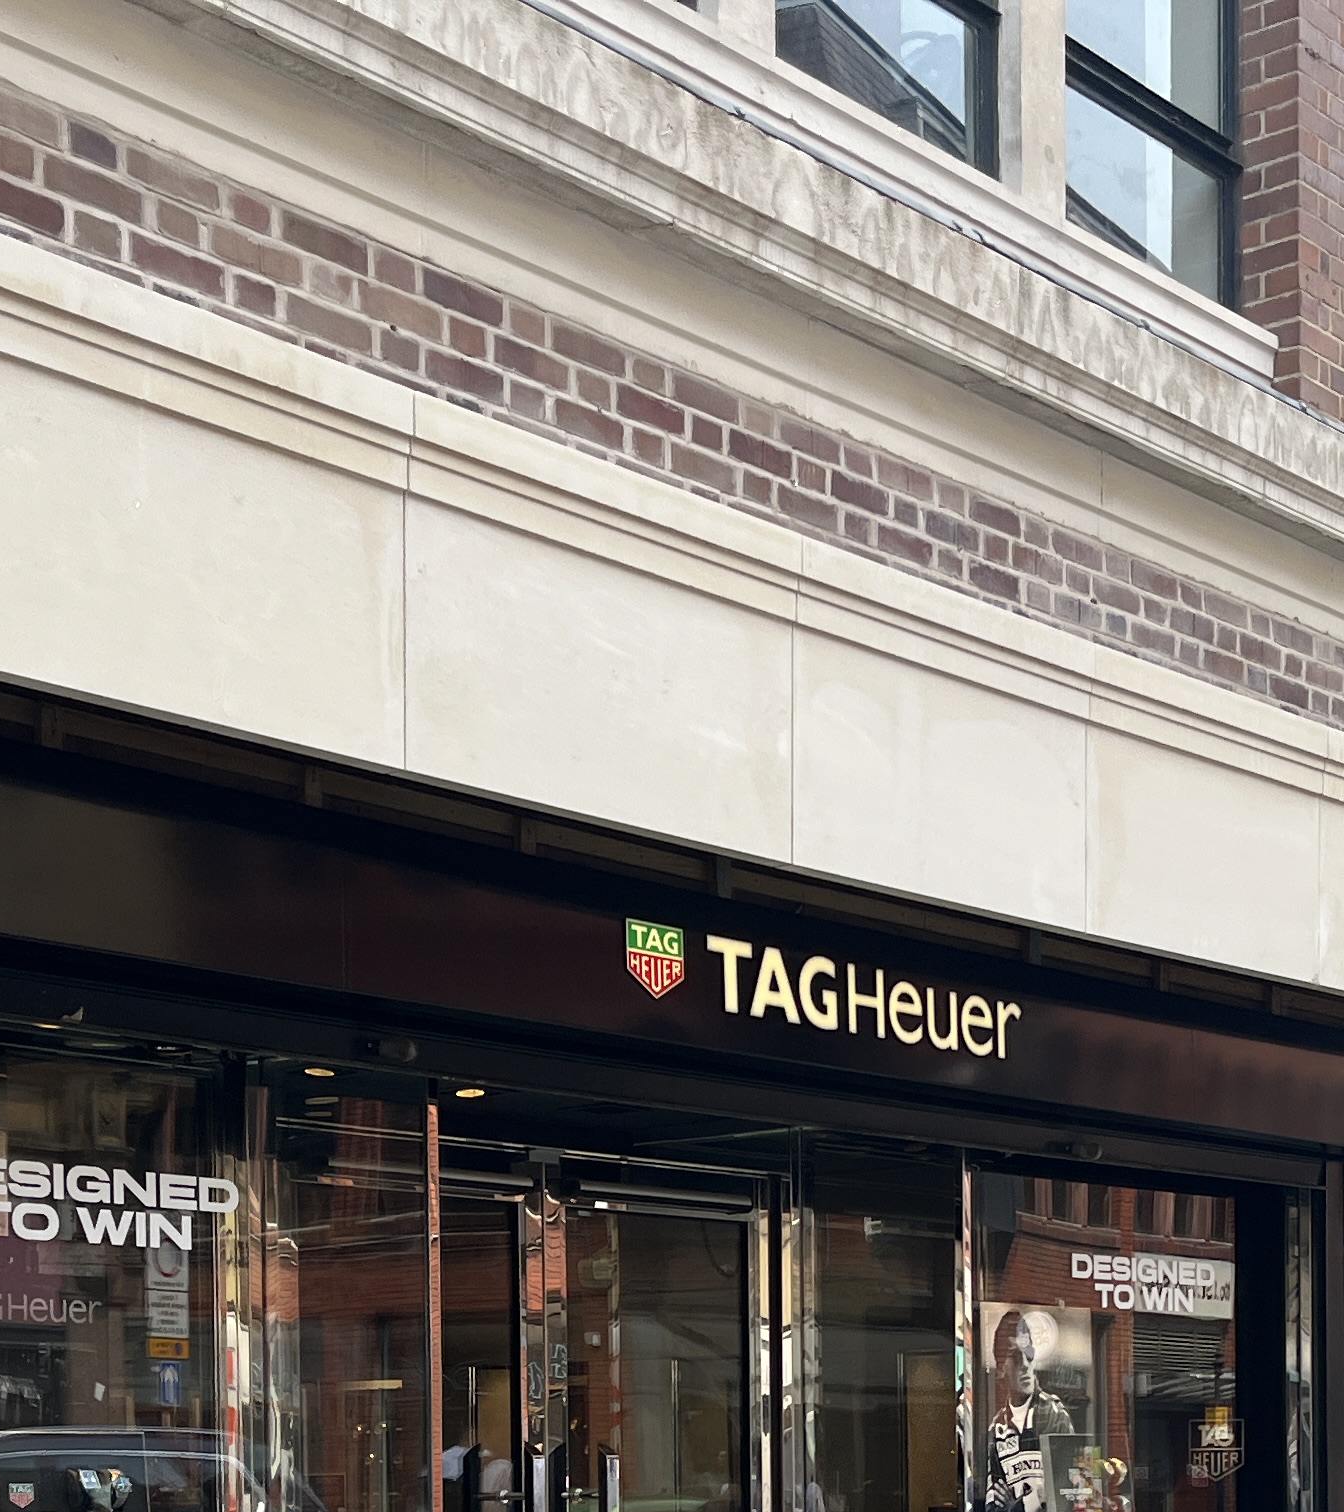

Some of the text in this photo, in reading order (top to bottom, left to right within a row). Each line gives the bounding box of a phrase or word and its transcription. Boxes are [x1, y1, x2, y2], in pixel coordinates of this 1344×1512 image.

[630, 923, 679, 955] TAG
[630, 953, 682, 993] HEUER
[75, 1206, 193, 1251] WIN
[1071, 1252, 1216, 1287] DESIGNED
[1094, 1282, 1135, 1310] TO
[1142, 1285, 1194, 1313] WIN
[1197, 1424, 1235, 1447] TAG
[1193, 1451, 1239, 1477] HEUER
